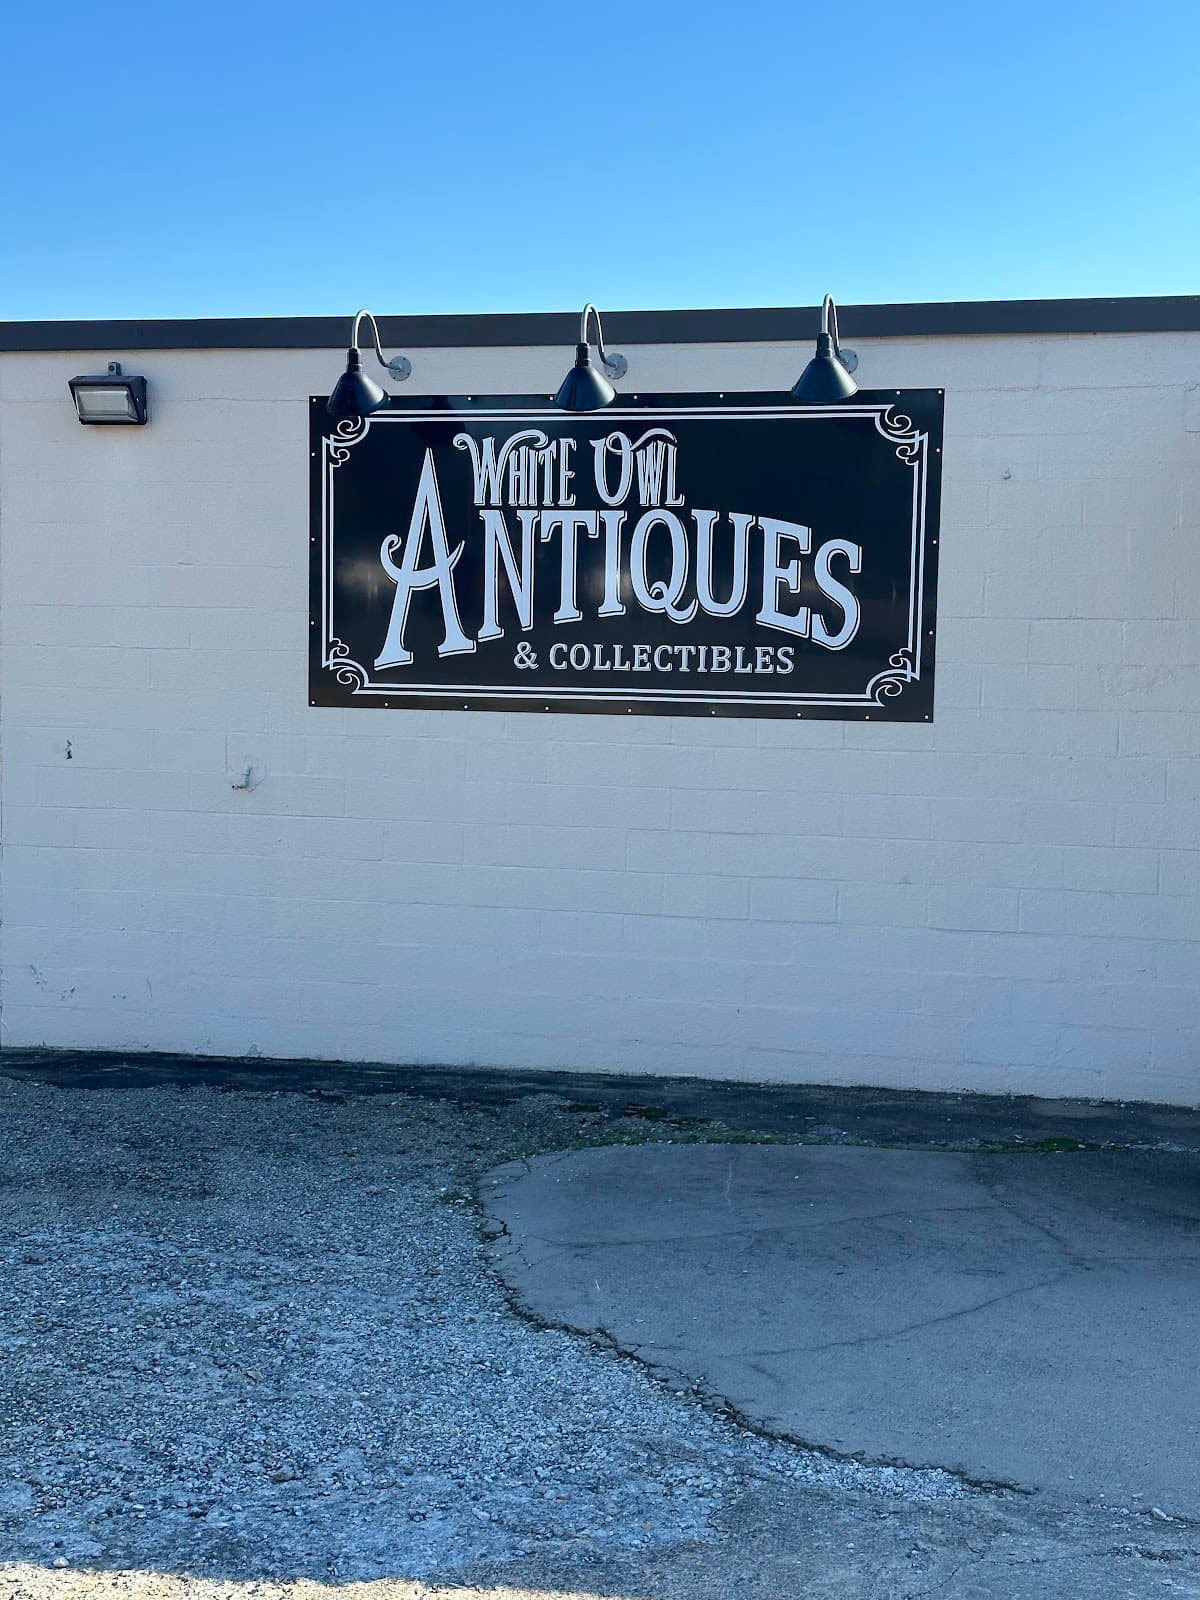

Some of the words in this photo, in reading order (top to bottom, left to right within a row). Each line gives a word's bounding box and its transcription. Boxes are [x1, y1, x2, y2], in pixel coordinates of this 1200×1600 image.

[452, 429, 577, 507] WHITE
[589, 427, 685, 507] OWL
[373, 447, 863, 671] ANTIQUES
[513, 641, 539, 671] &
[549, 642, 795, 675] COLLECTIBLES
